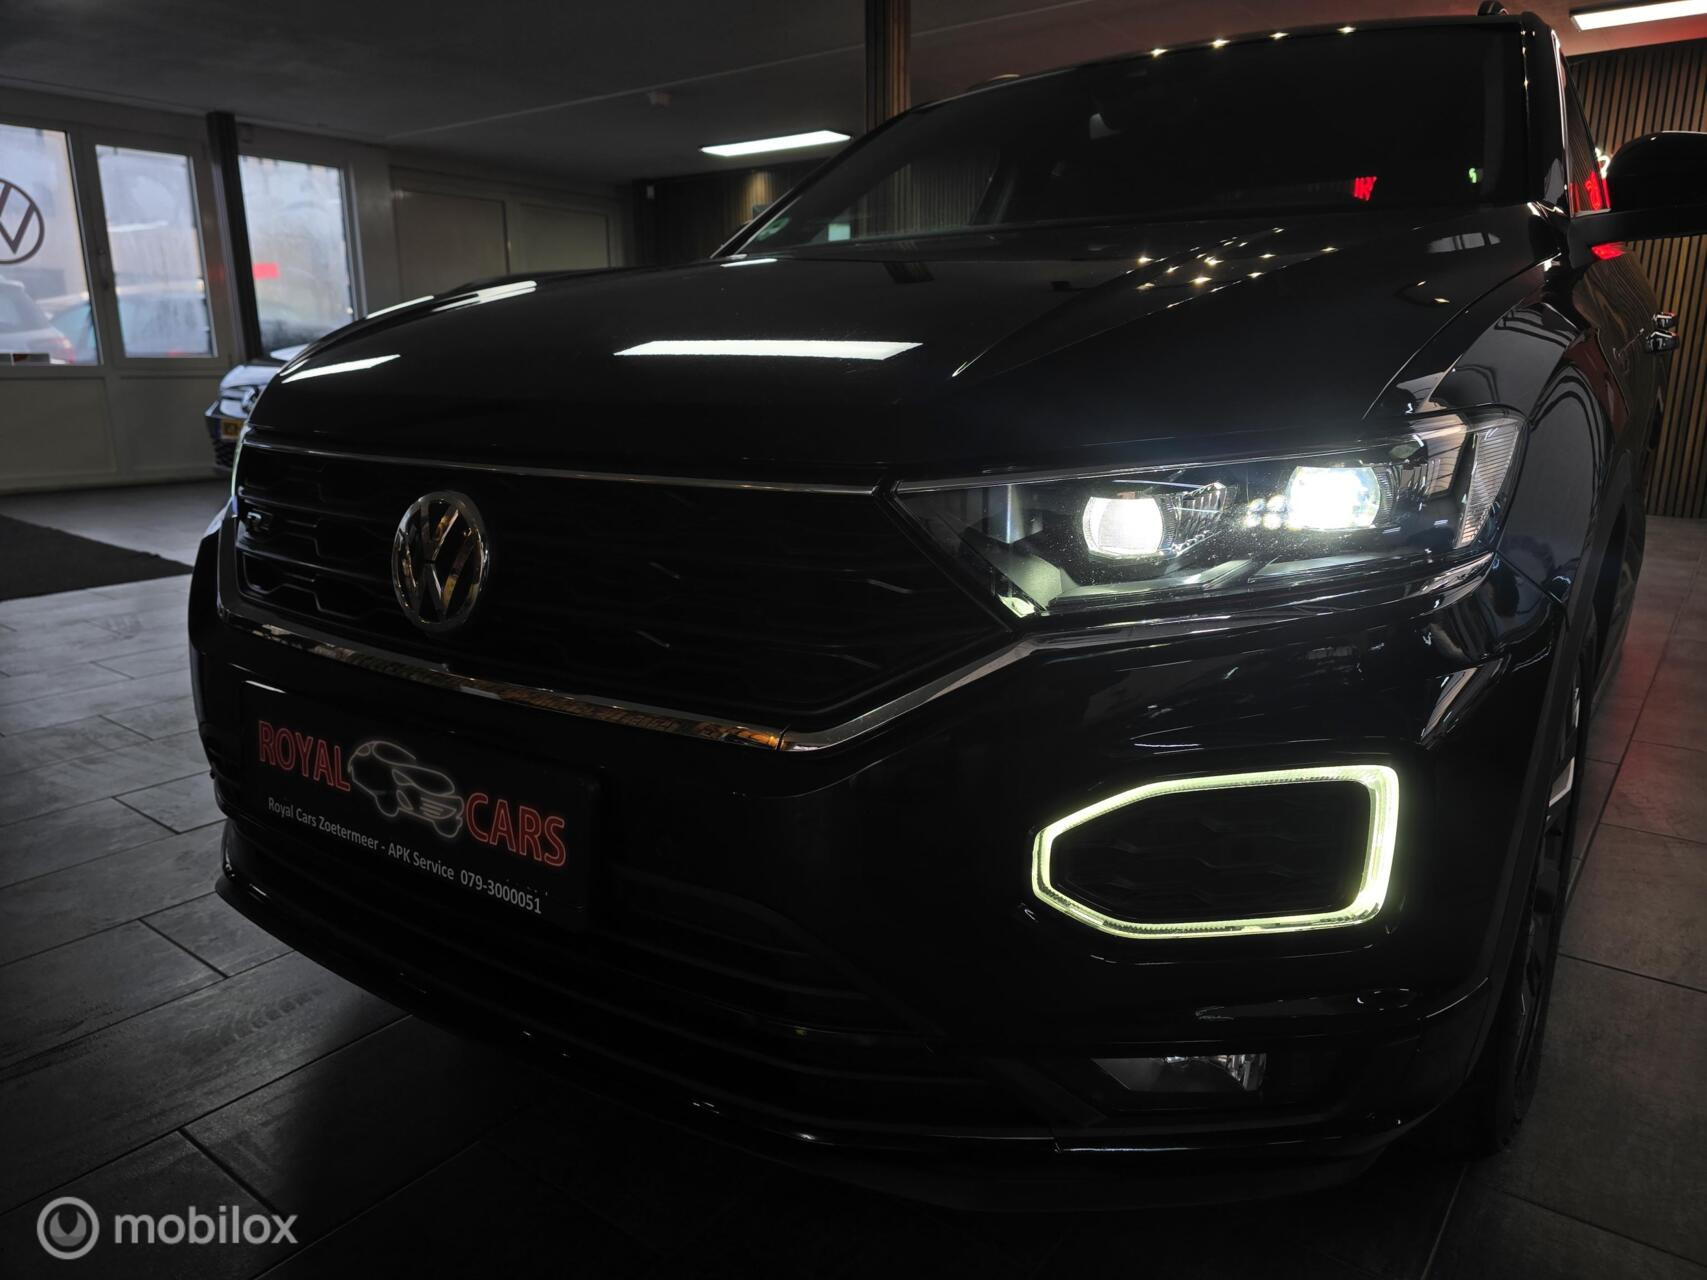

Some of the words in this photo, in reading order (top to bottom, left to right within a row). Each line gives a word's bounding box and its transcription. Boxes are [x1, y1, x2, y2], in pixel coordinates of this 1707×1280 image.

[258, 720, 351, 792] ROYAL
[466, 792, 567, 867] CARS
[268, 797, 294, 818] Royal
[296, 808, 317, 828] Cars
[318, 815, 379, 851] Zoetermeer
[388, 842, 411, 864] APK
[413, 851, 455, 880] Service
[460, 869, 542, 915] 079-3000051
